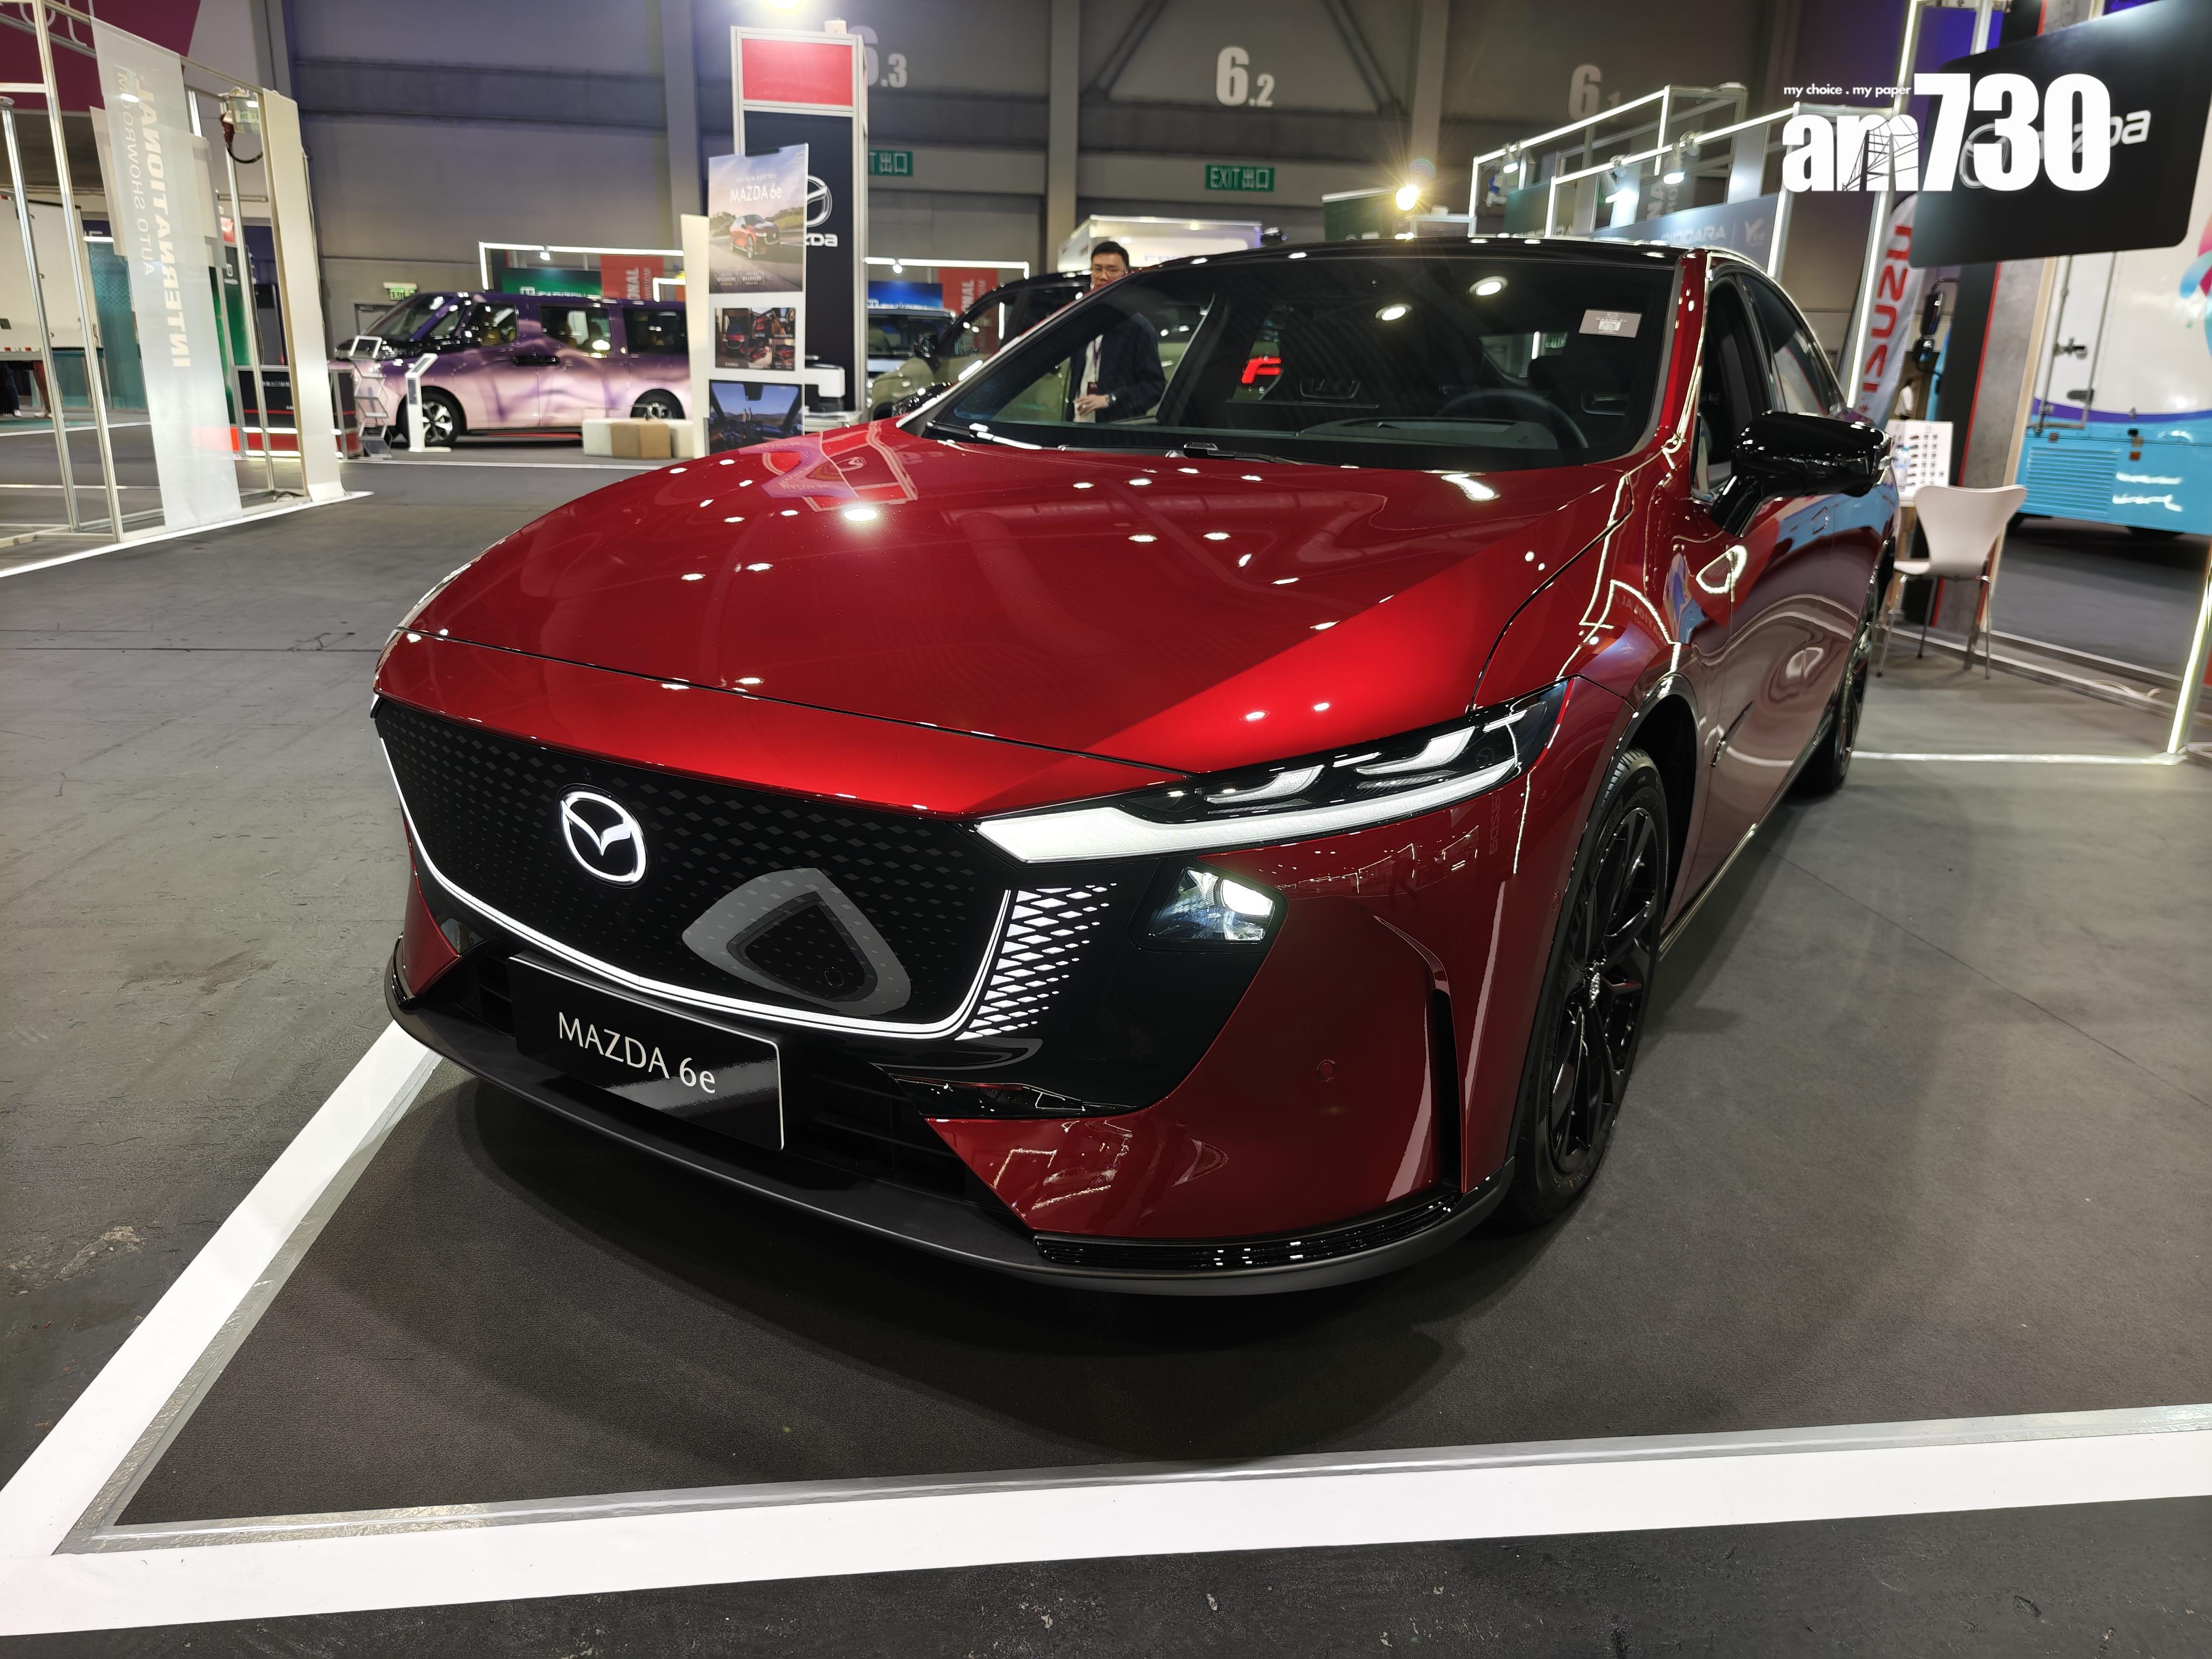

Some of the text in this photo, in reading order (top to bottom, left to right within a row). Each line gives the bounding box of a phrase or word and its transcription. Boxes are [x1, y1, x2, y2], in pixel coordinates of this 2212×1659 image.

[1216, 46, 1274, 107] 6.2
[1568, 64, 1620, 123] 61
[731, 183, 783, 203] MAZDA 6e
[1210, 167, 1269, 188] EXIT 出口
[559, 1011, 716, 1094] MAZDA 6e
